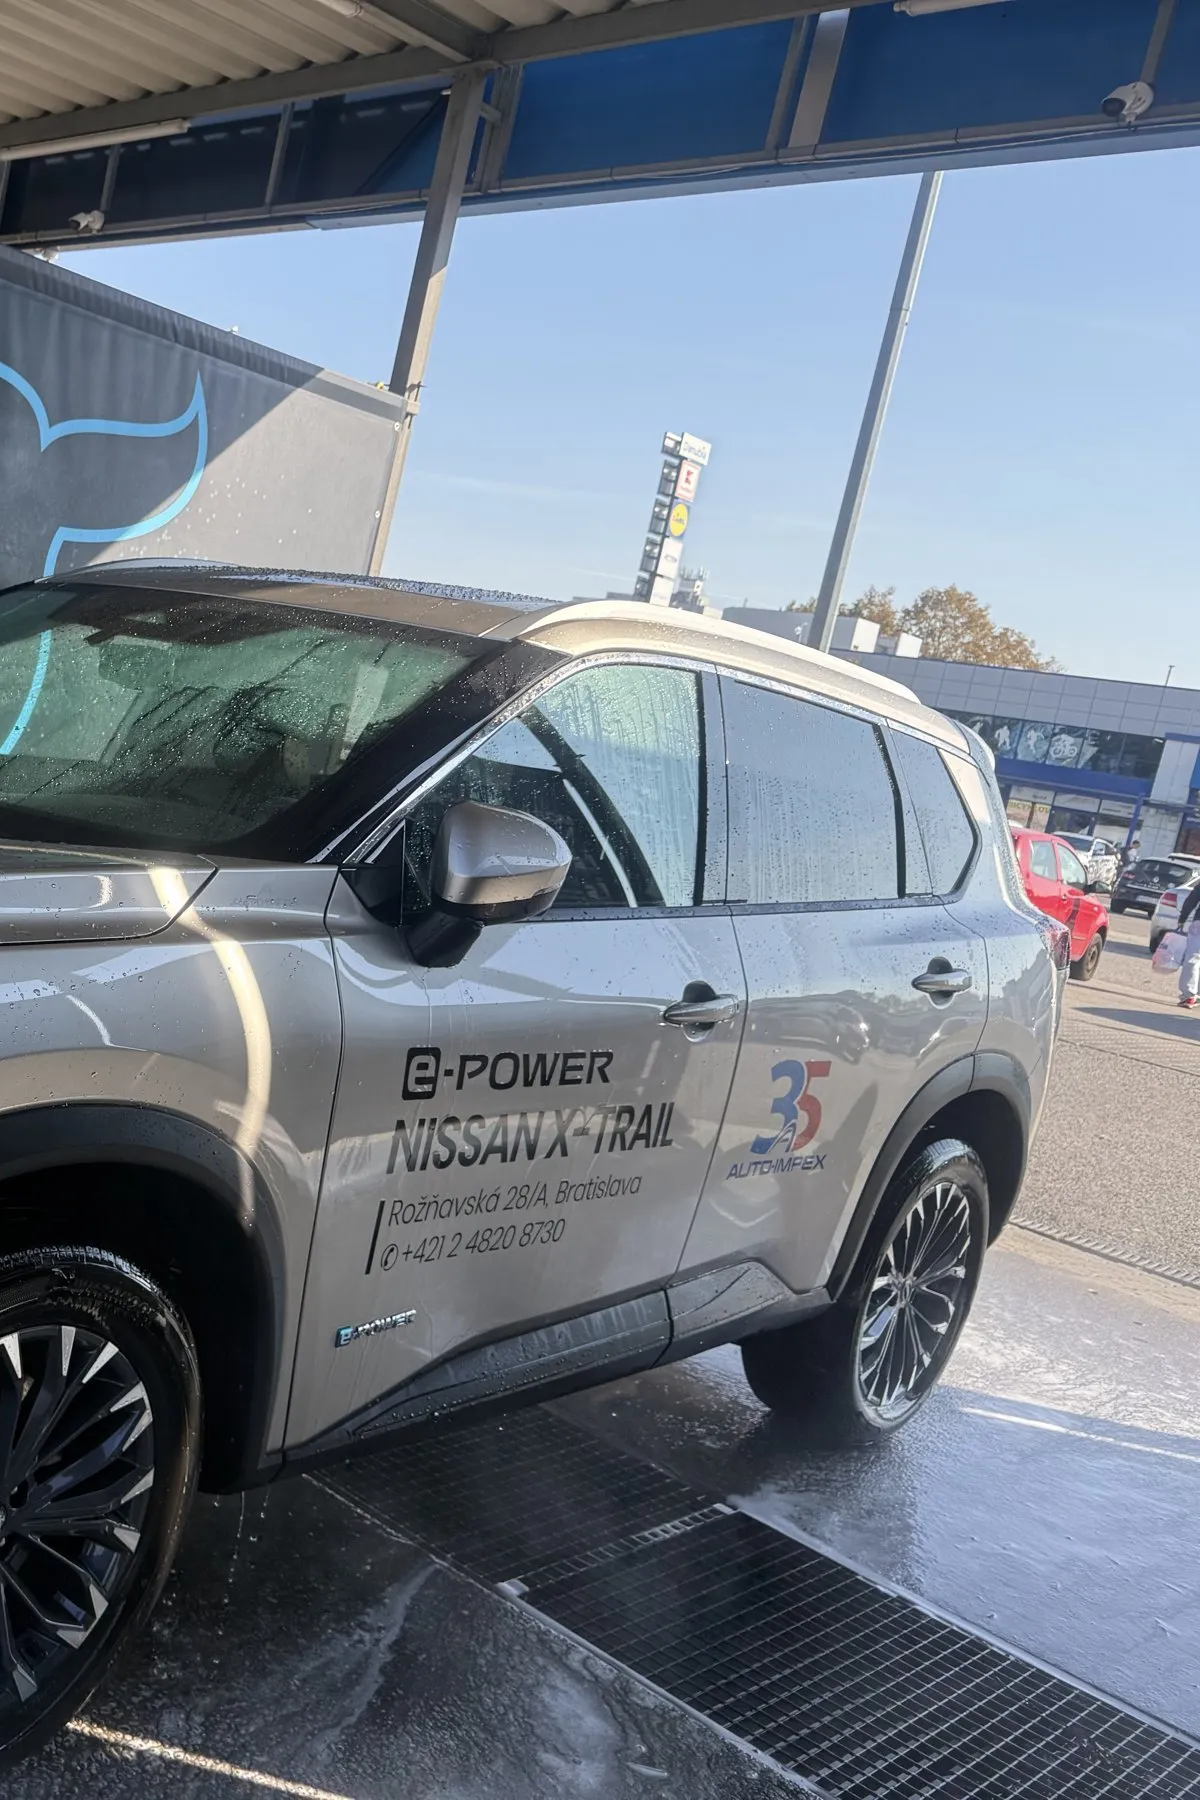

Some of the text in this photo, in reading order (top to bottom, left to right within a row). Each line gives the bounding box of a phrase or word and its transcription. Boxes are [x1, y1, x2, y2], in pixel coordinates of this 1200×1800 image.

[402, 1046, 614, 1101] e-POWER
[750, 1059, 832, 1155] 35
[386, 1101, 675, 1175] NISSAN X-TRAIL
[388, 1174, 643, 1227] Rožňavská 28/A, Bratislava
[402, 1218, 566, 1263] +421 2 4820 8730
